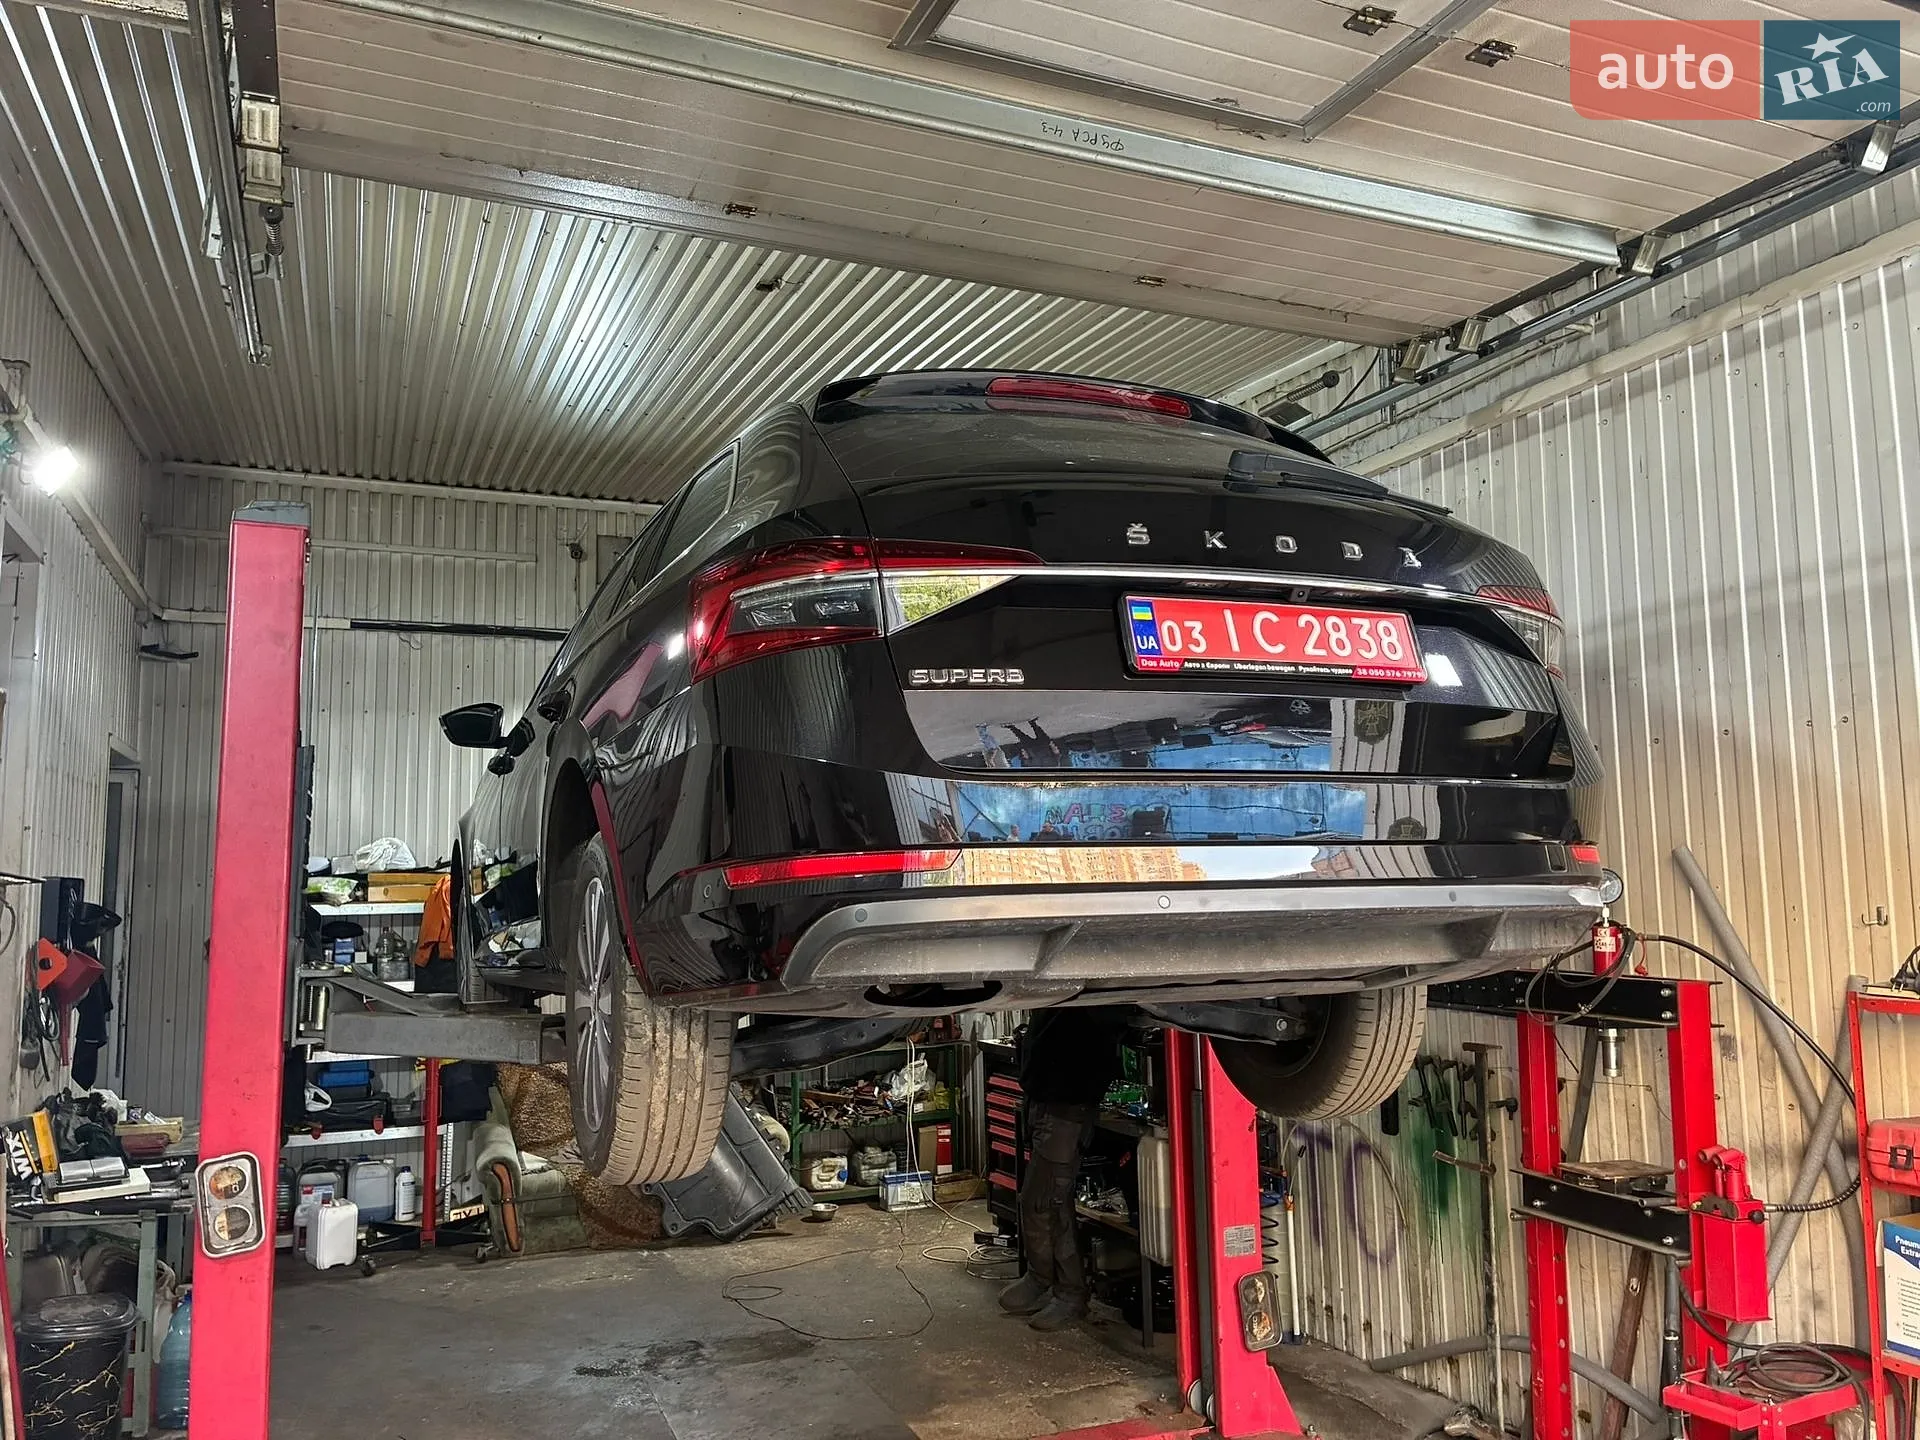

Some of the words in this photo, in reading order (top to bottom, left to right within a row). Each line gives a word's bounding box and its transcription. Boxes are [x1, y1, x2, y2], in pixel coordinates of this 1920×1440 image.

[1136, 635, 1159, 650] UA
[1161, 619, 1208, 653] 03
[1222, 608, 1286, 654] IC
[1298, 612, 1404, 661] 2838
[1141, 658, 1158, 667] Das
[1159, 659, 1180, 668] Auto
[909, 669, 1025, 686] SUPERB
